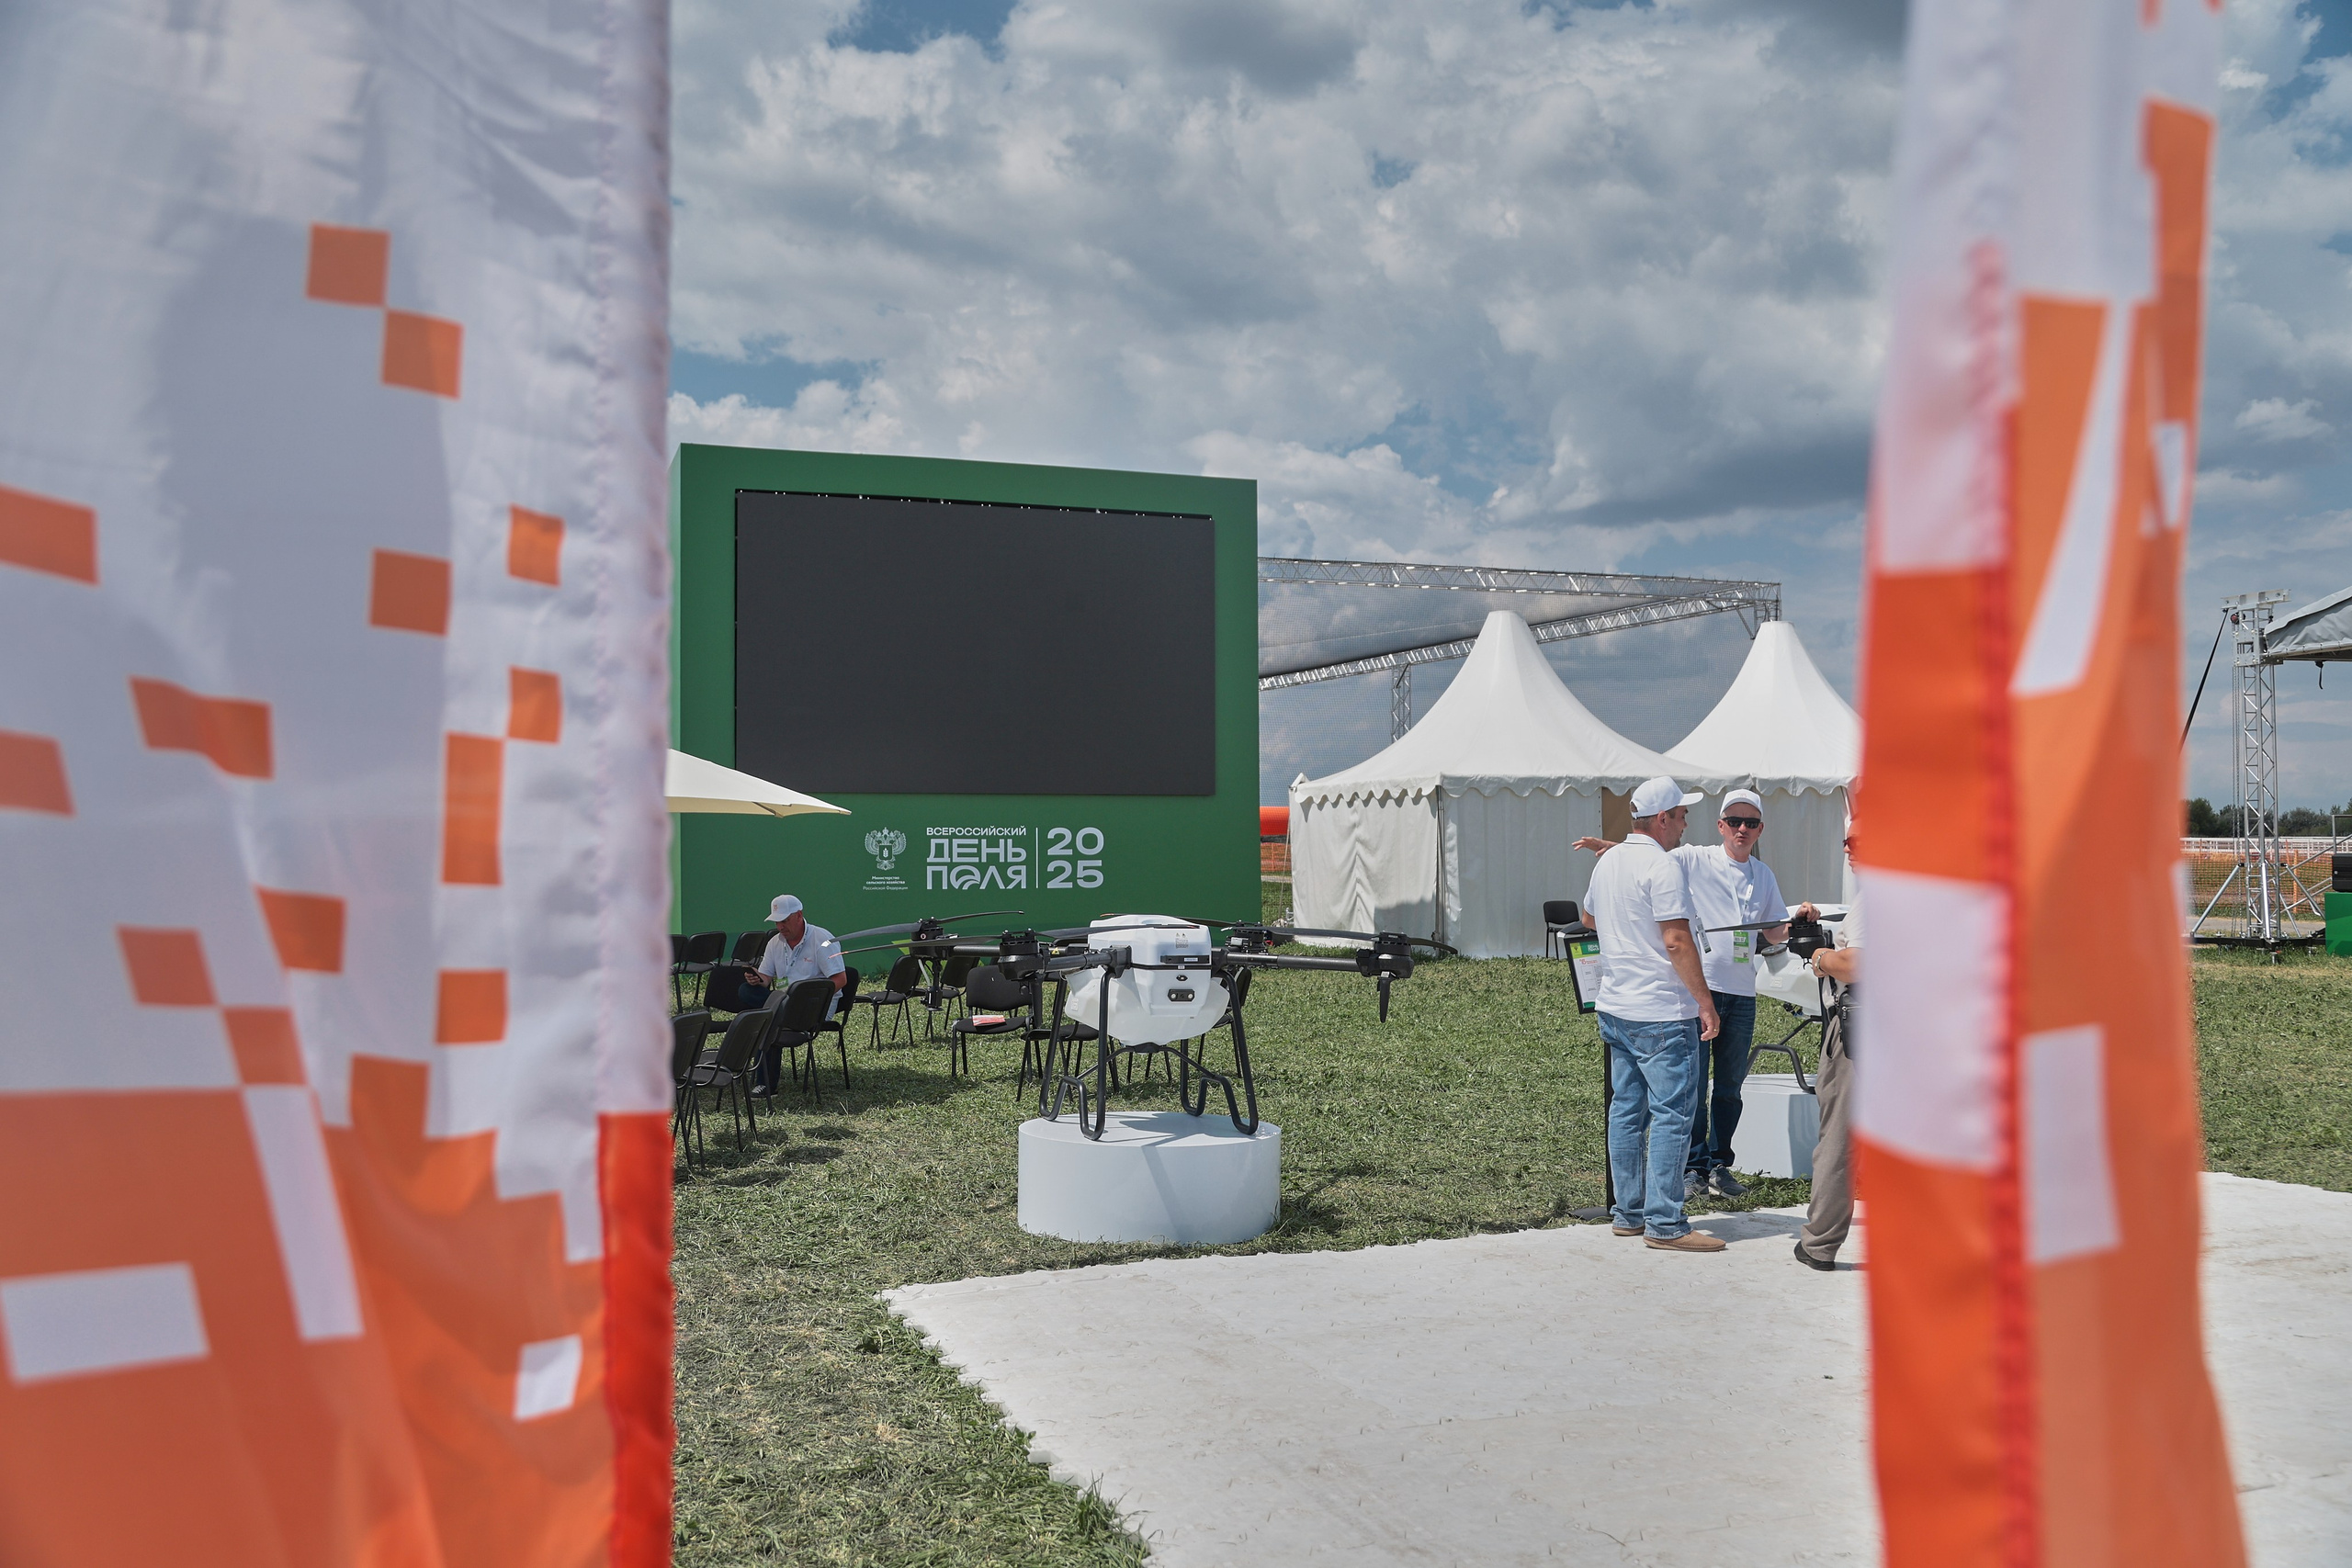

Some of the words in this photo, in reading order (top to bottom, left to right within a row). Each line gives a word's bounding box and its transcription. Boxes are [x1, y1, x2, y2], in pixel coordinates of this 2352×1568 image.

[926, 826, 1027, 836] ВСЕРОССИЙСКИЙ
[1046, 827, 1104, 855] 20
[926, 839, 1027, 863] ДЕНЬ
[926, 865, 1027, 889] ПОЛЯ
[1046, 860, 1104, 888] 25
